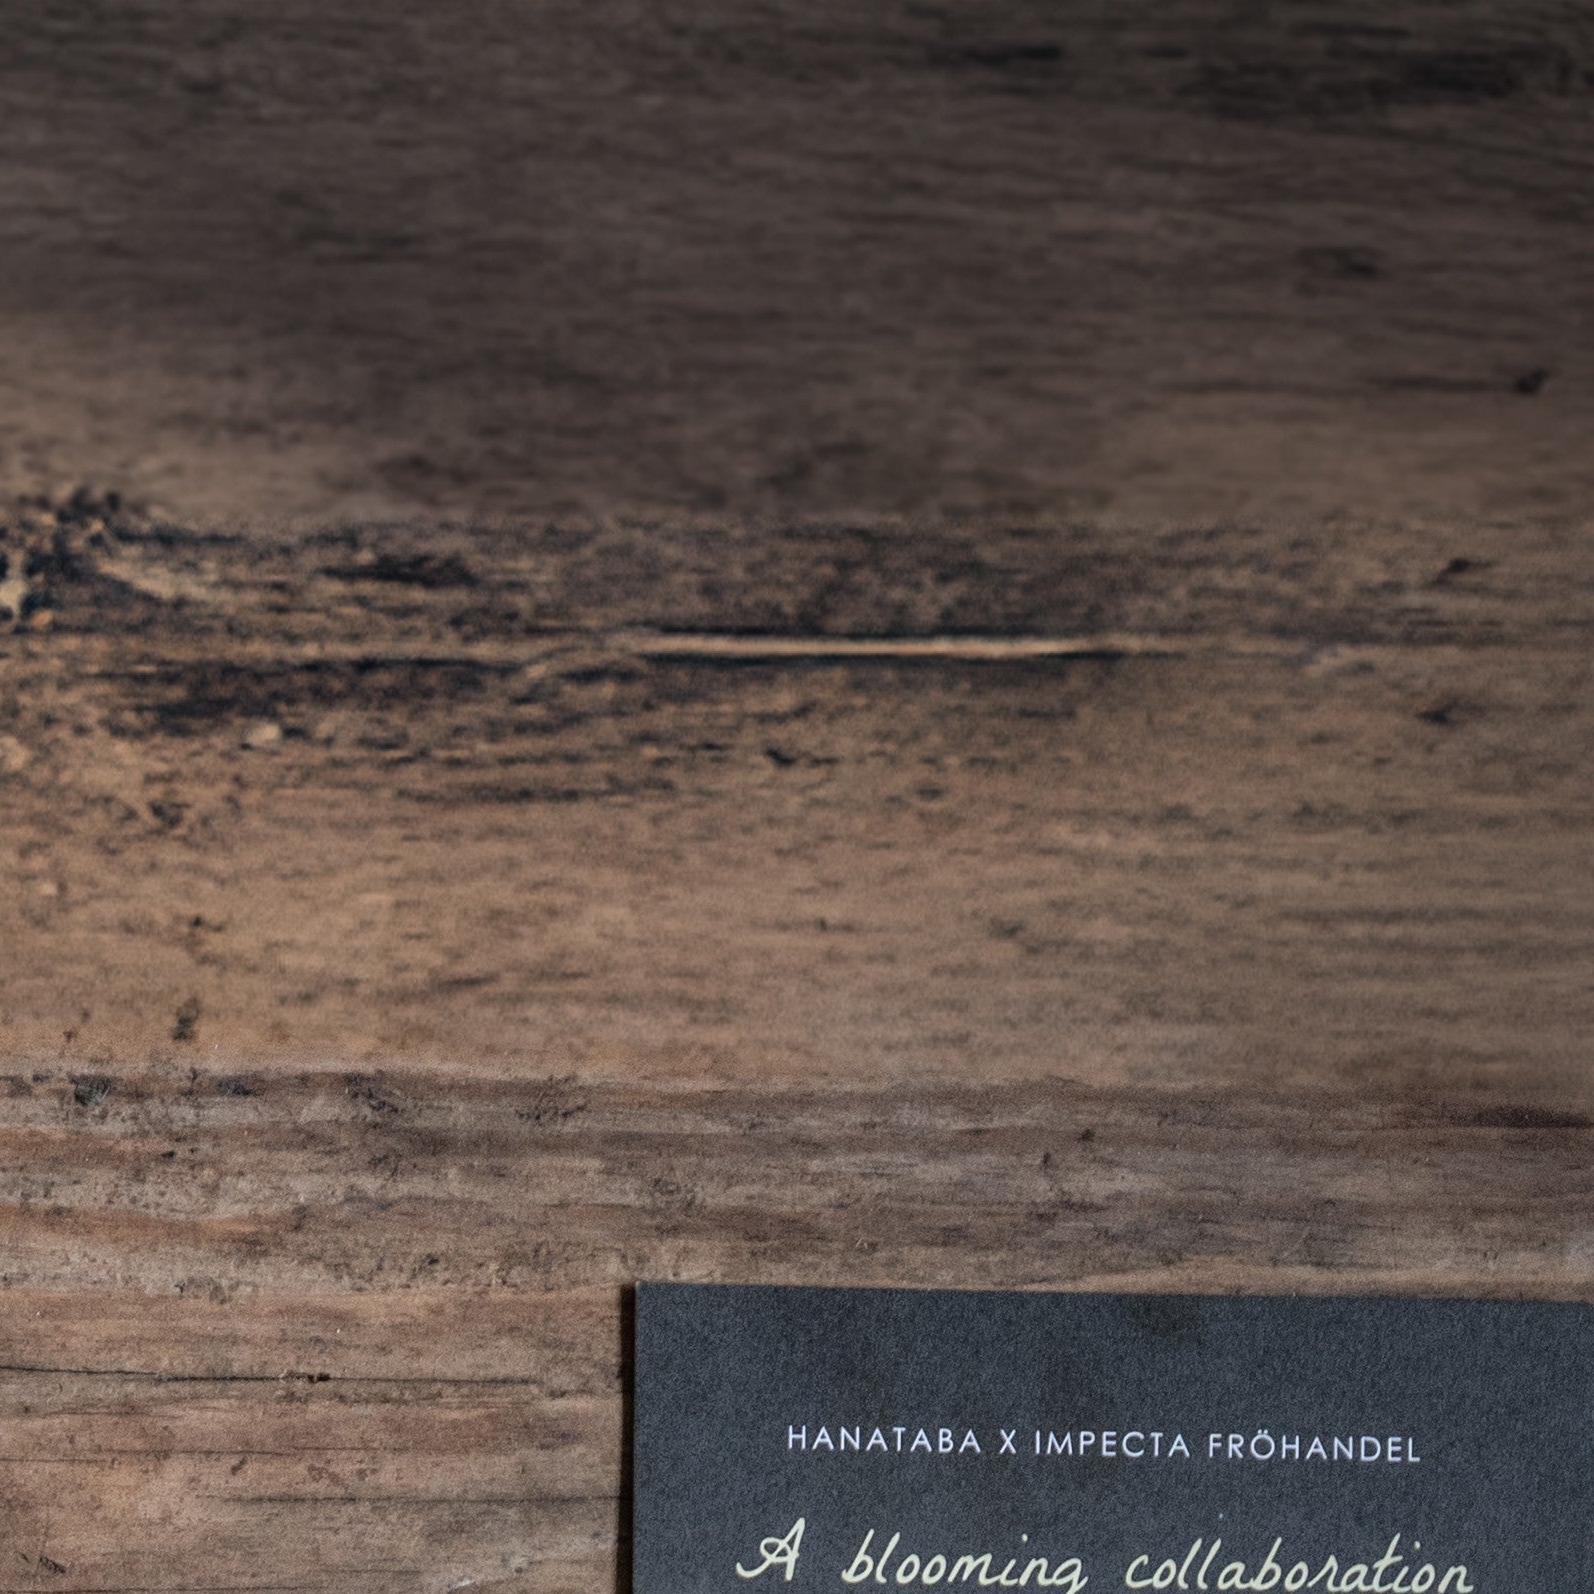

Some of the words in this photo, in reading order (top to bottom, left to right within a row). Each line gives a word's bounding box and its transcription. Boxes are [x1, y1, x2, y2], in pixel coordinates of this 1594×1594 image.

[787, 1424, 982, 1454] HANATABA
[998, 1428, 1017, 1455] X
[1034, 1429, 1190, 1458] IMPECTA
[1208, 1428, 1421, 1463] FRÖHANDEL
[736, 1516, 805, 1582] A
